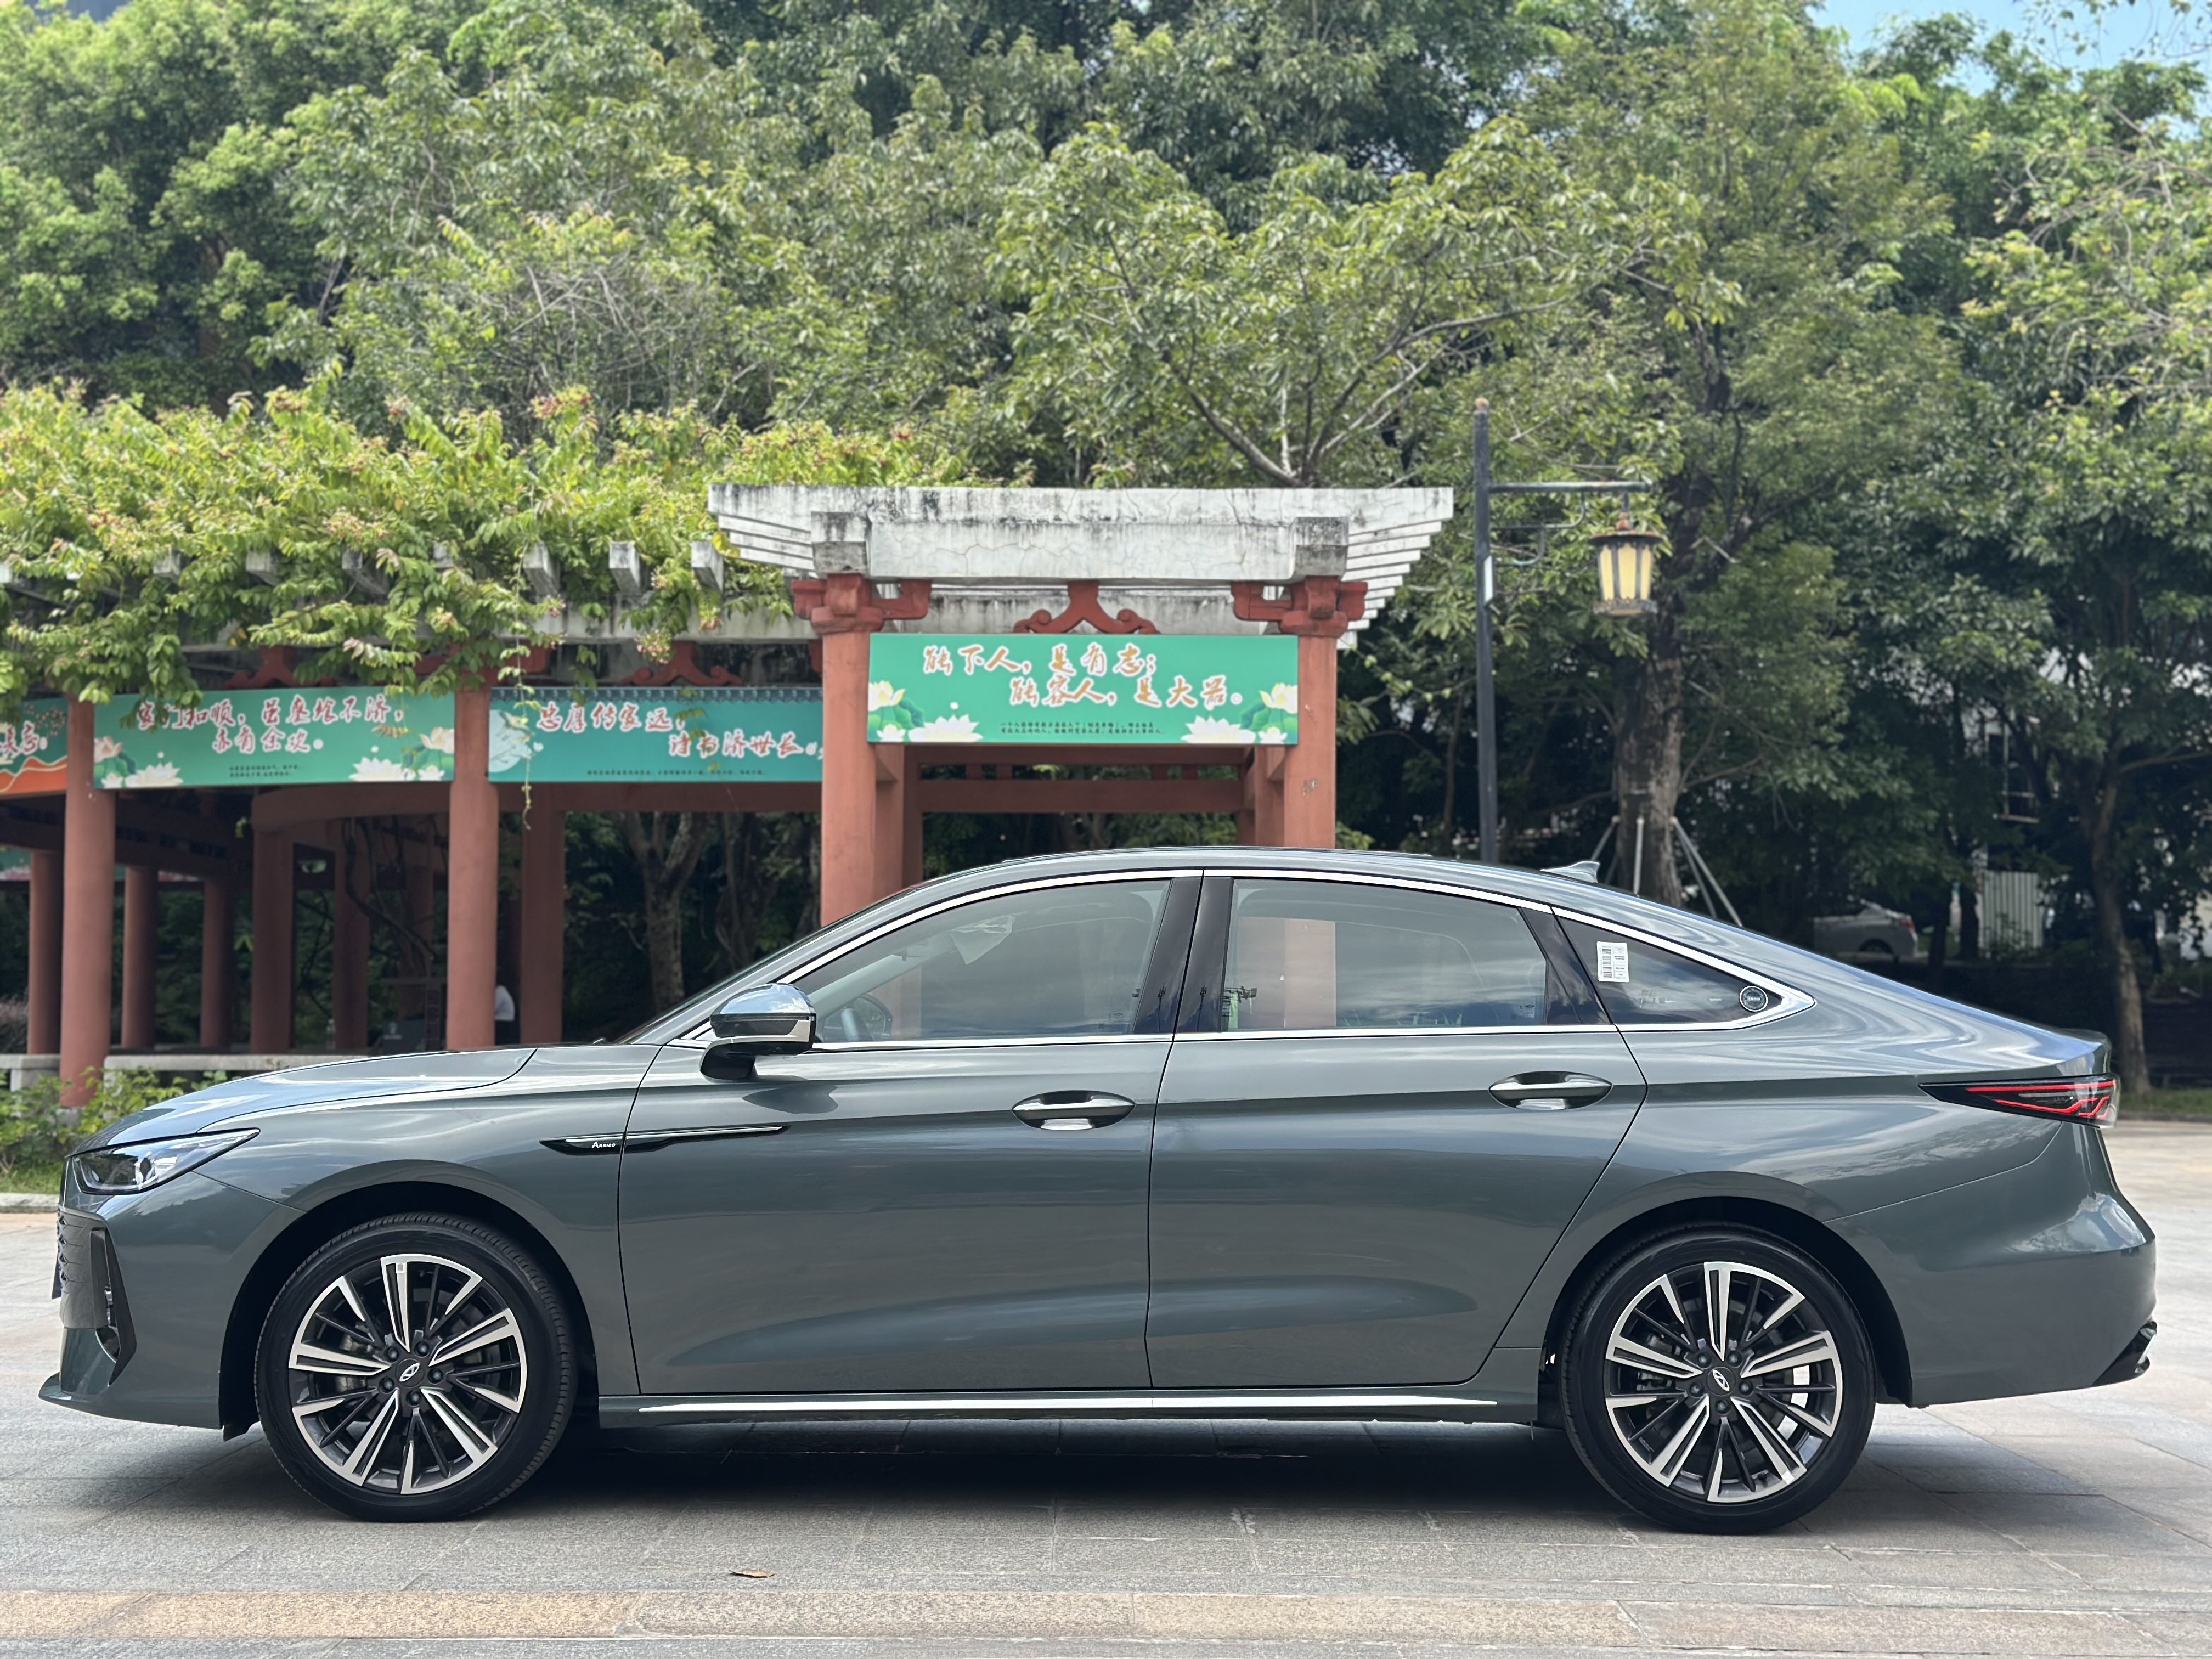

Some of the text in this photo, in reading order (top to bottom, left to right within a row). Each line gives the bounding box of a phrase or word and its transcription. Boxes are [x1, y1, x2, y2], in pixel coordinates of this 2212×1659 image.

[923, 641, 1156, 676] 能下人，是有志；
[1009, 674, 1243, 710] 能容人，是大器。
